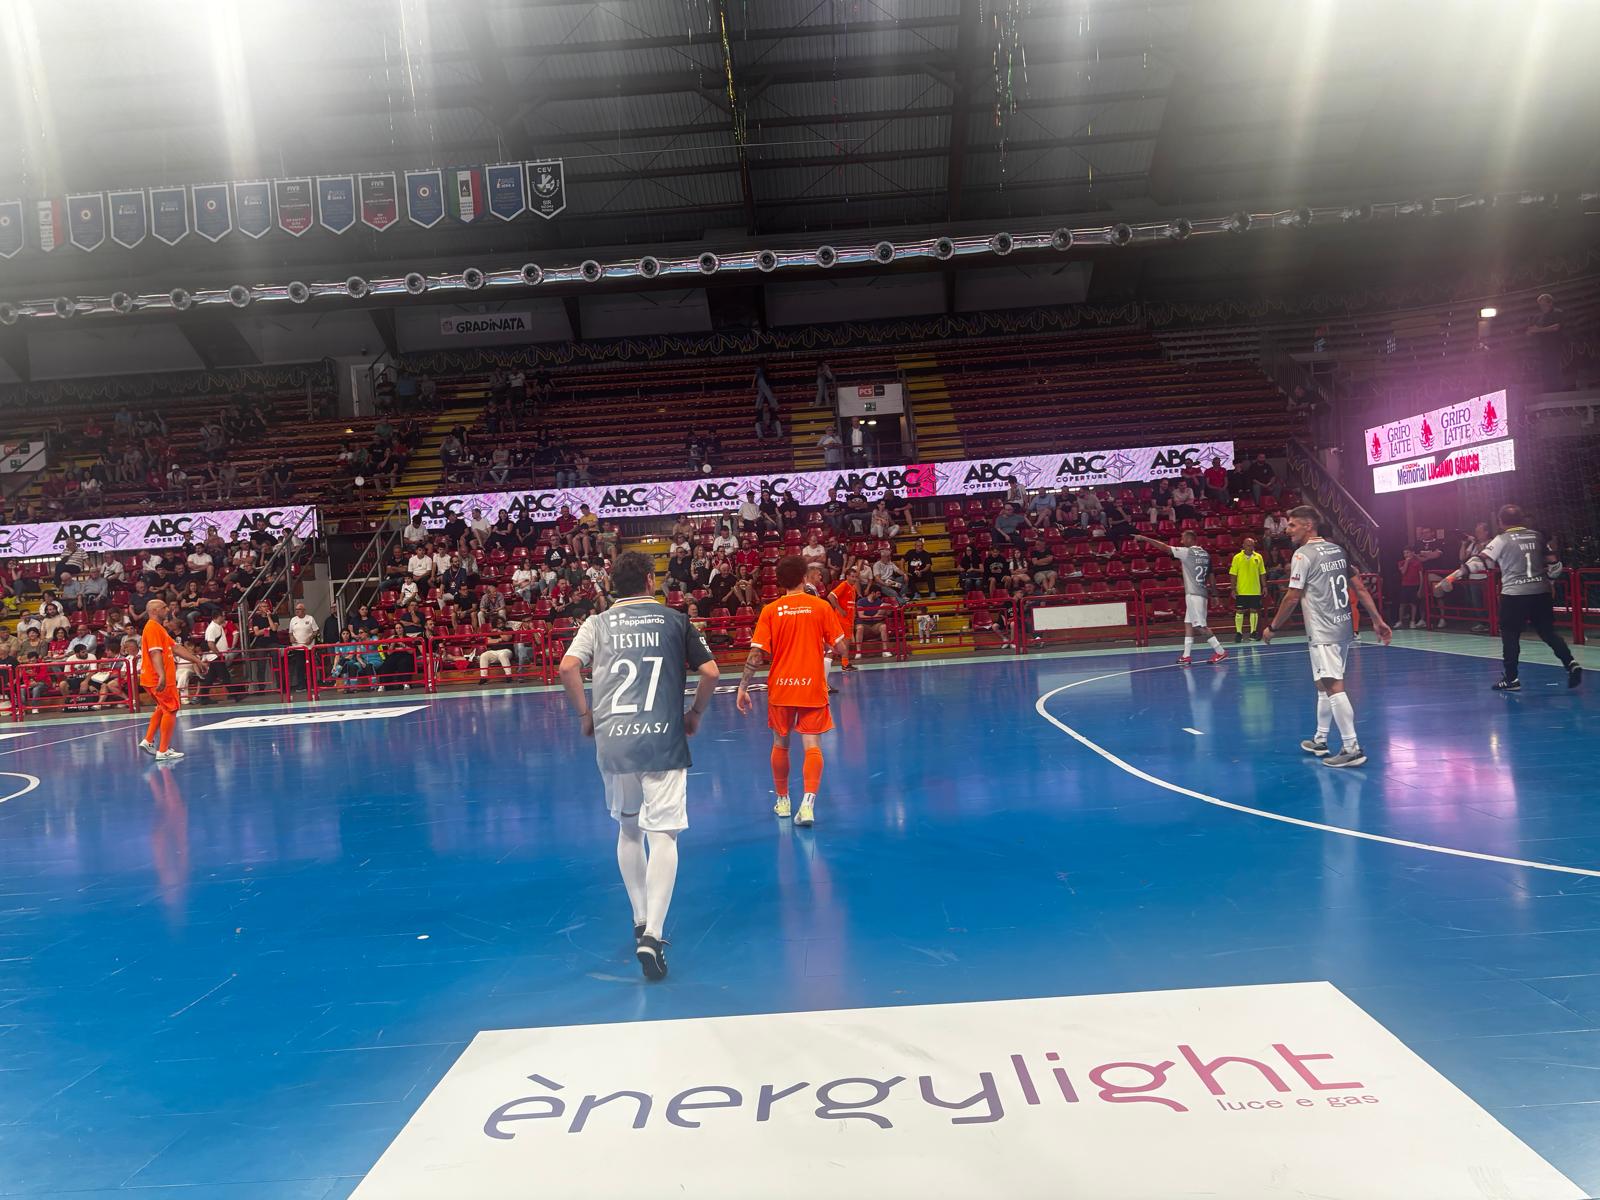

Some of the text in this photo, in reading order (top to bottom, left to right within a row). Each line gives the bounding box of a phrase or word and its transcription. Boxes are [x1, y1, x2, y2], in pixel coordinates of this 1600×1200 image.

[1441, 407, 1471, 429] GRIFO
[1387, 424, 1410, 442] GRIFO
[1444, 423, 1471, 446] LATTE
[1390, 438, 1411, 457] LATTE
[1056, 455, 1107, 476] ABC
[1150, 448, 1200, 469] ABC
[963, 462, 1013, 484] ABC
[1055, 473, 1108, 483] COPERTURE
[1150, 468, 1180, 476] COPER
[1397, 463, 1427, 486] Memorial
[690, 482, 739, 503] ABC
[760, 478, 789, 497] BC
[963, 481, 1009, 490] COPERTUR
[508, 494, 556, 514] ABC
[600, 487, 648, 508] ABC
[689, 500, 740, 509] COPERTURE
[508, 512, 557, 520] CORTURE
[599, 505, 649, 514] COPERTURE
[53, 523, 102, 545] ABC
[144, 517, 193, 538] ABC
[53, 541, 103, 550] CORTURE
[1525, 552, 1532, 578] 1
[1329, 574, 1349, 610] 13
[619, 616, 665, 627] Pappalardo
[611, 632, 660, 649] TESTINI
[610, 656, 664, 714] 27
[483, 1043, 1364, 1139] ènergylight
[1216, 1094, 1380, 1111] luce e gas
